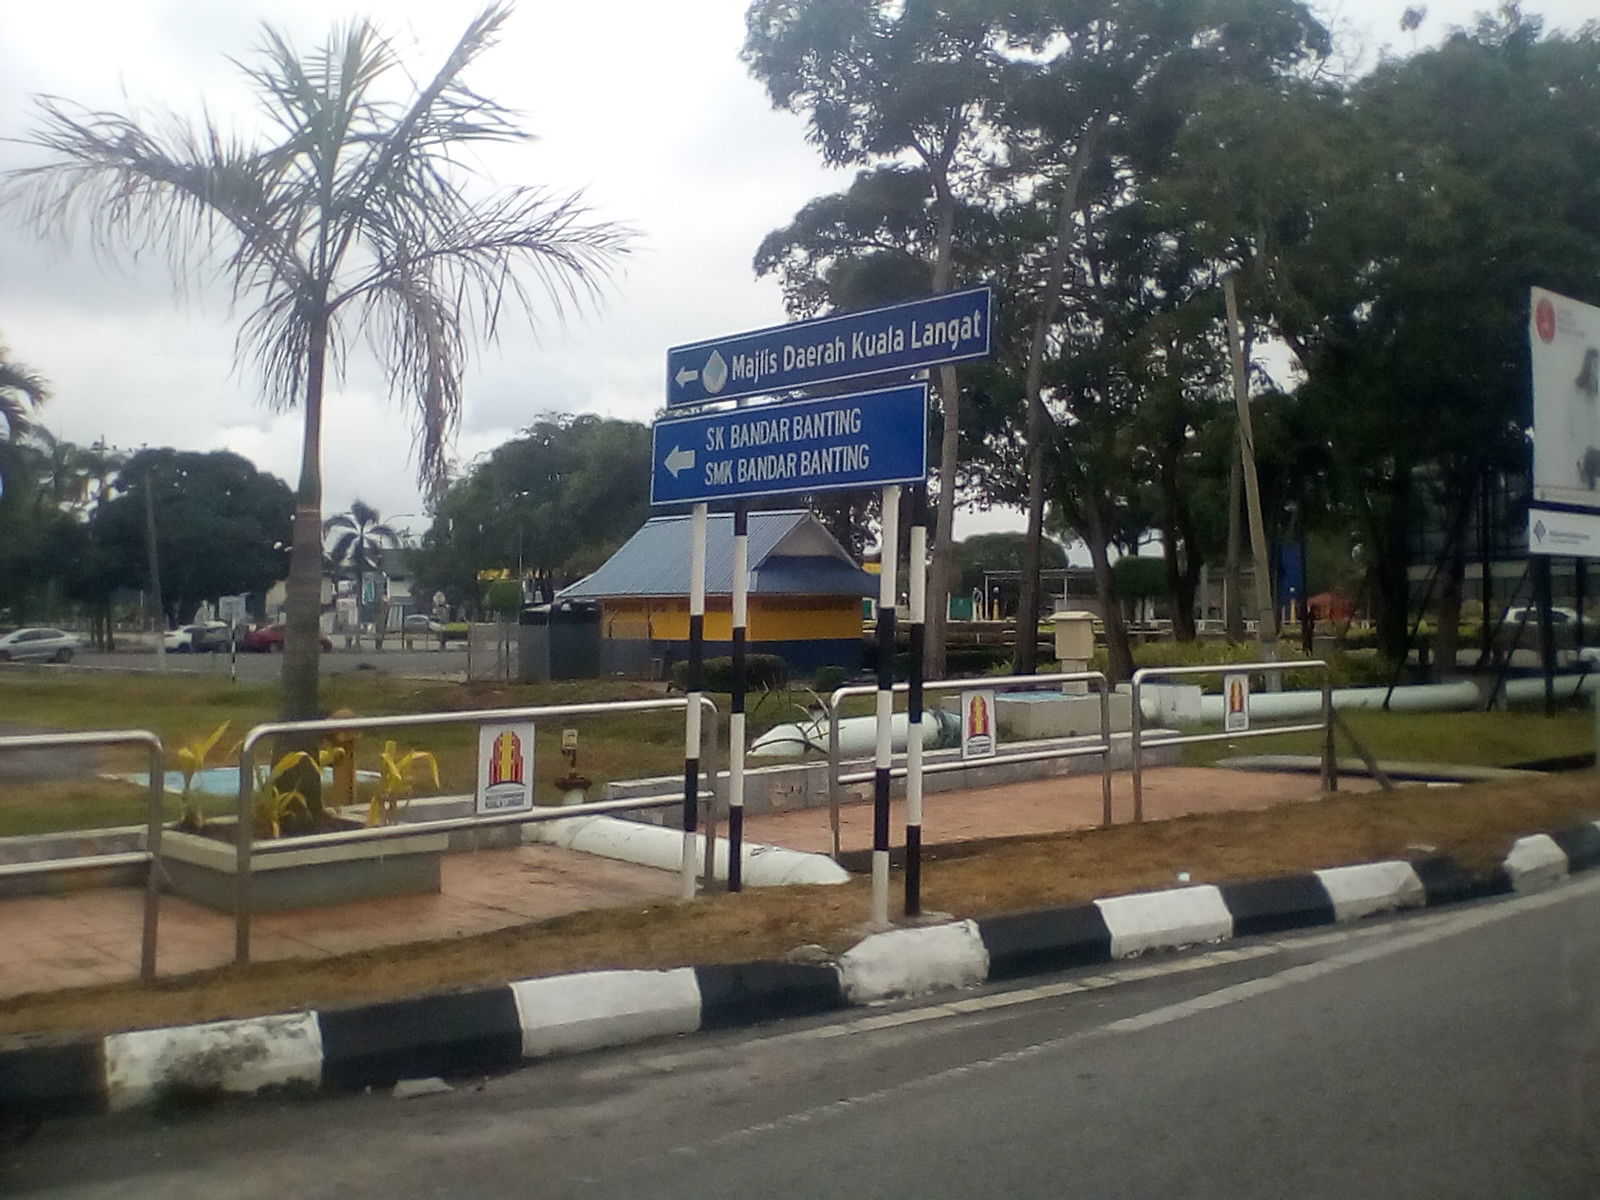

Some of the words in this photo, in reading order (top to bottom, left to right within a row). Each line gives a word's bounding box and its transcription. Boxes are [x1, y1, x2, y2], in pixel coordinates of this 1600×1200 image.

[731, 348, 778, 384] Majlis
[783, 335, 846, 372] Daerah
[852, 324, 904, 360] Kuala
[911, 309, 982, 351] Langat
[705, 427, 724, 451] SK
[730, 417, 790, 449] BANDAR
[793, 407, 862, 441] BANTING
[704, 459, 733, 486] SMK
[737, 452, 797, 484] BANDAR
[800, 443, 869, 477] BANTING
